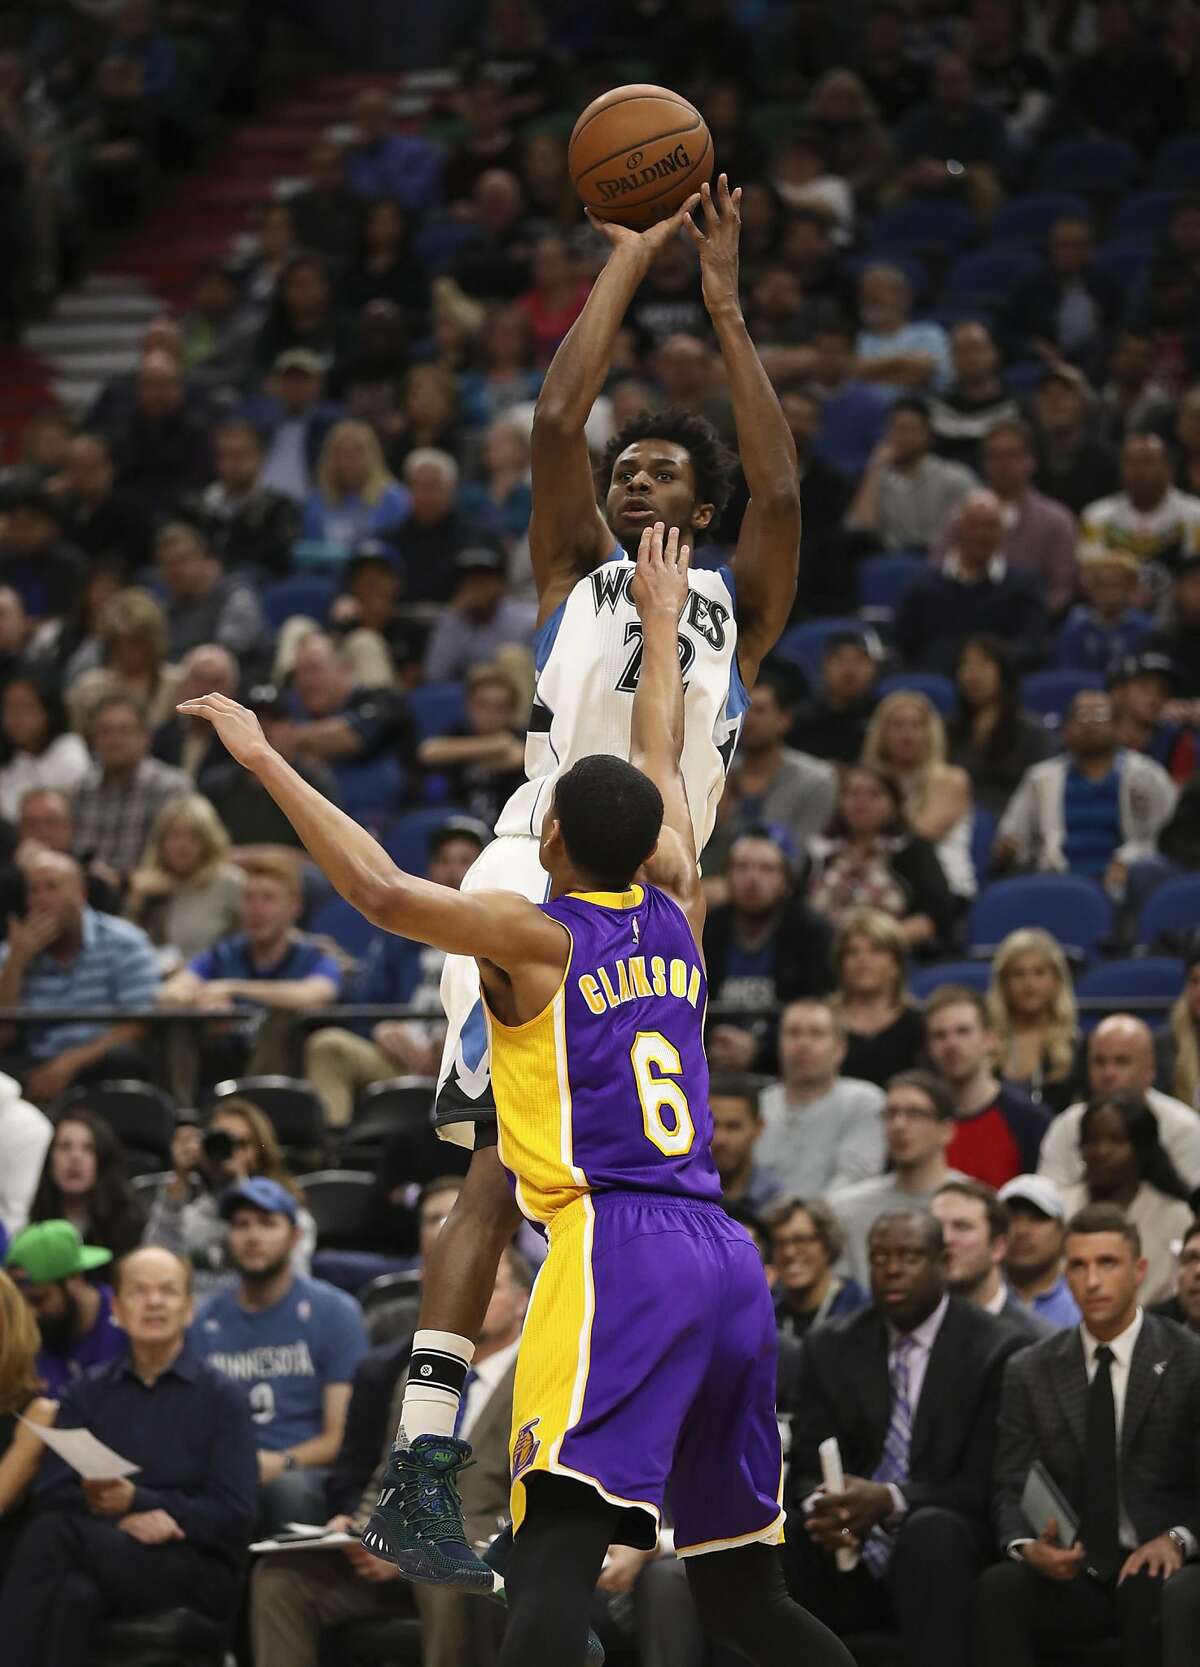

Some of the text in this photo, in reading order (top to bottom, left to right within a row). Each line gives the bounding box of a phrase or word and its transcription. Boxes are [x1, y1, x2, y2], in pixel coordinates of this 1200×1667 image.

[595, 144, 691, 201] SPALDING
[587, 567, 730, 652] WES
[630, 1031, 696, 1157] 6
